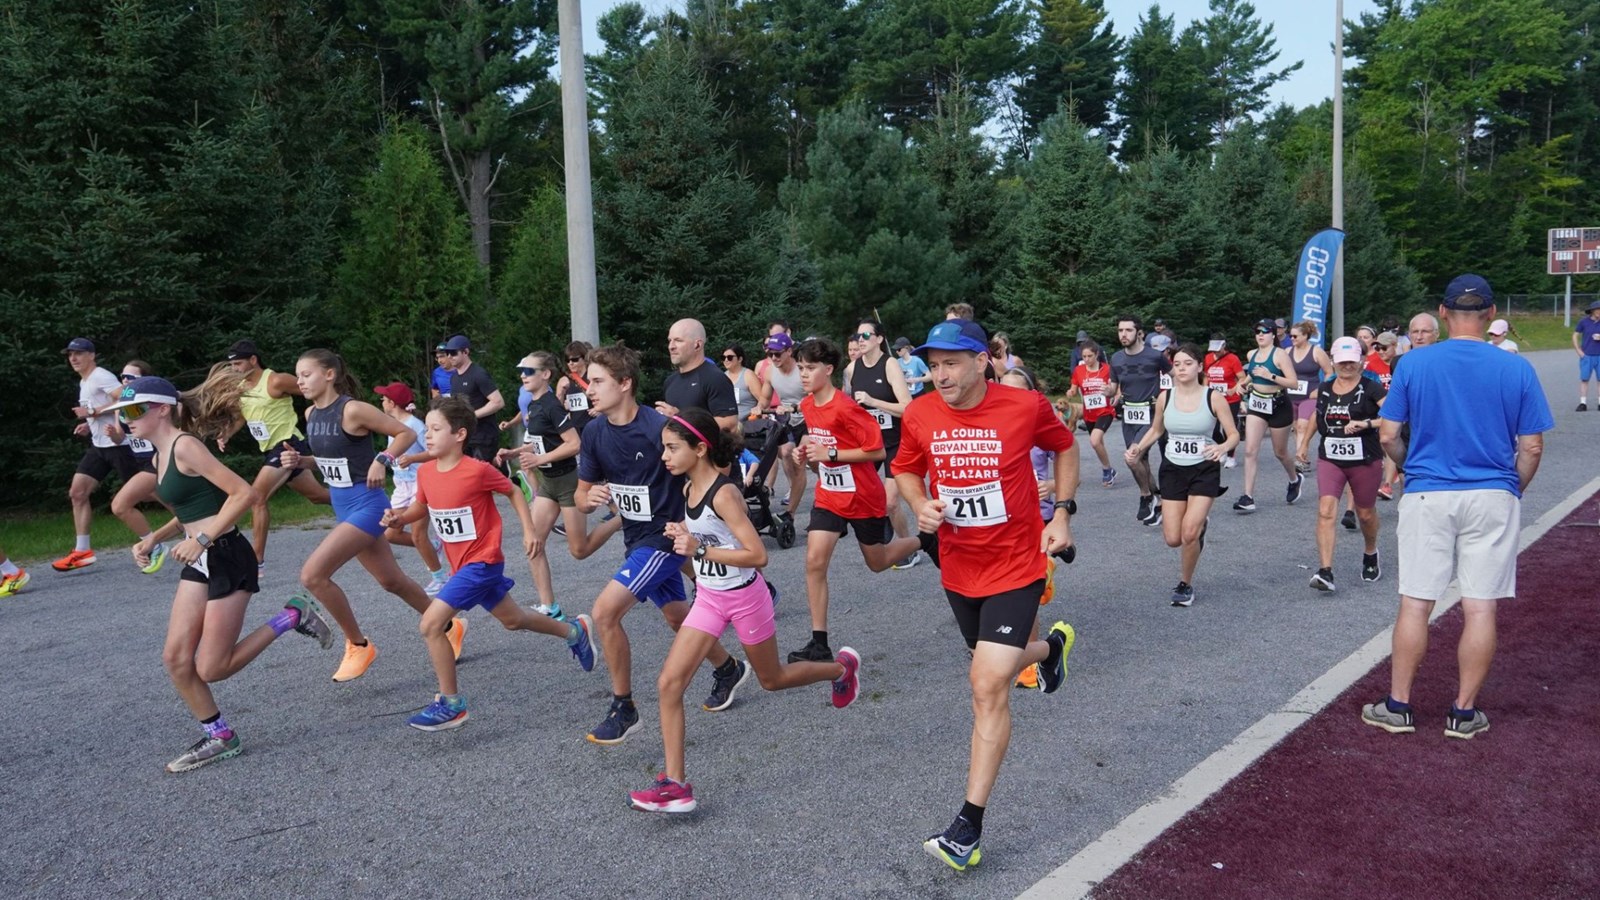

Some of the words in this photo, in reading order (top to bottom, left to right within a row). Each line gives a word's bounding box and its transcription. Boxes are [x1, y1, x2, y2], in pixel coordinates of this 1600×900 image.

[569, 398, 582, 407] 272
[1088, 397, 1102, 406] 262
[1252, 400, 1267, 410] 302
[1128, 411, 1144, 420] 092
[933, 430, 948, 440] LA
[951, 428, 997, 438] COURSE
[933, 443, 968, 453] BRYAN
[970, 443, 998, 452] LIEW
[1174, 441, 1198, 454] 346
[1331, 443, 1355, 455] 253
[949, 455, 999, 467] ÉDITION
[824, 472, 844, 486] 277
[616, 493, 641, 513] 296
[952, 495, 988, 518] 211
[435, 517, 463, 535] 331
